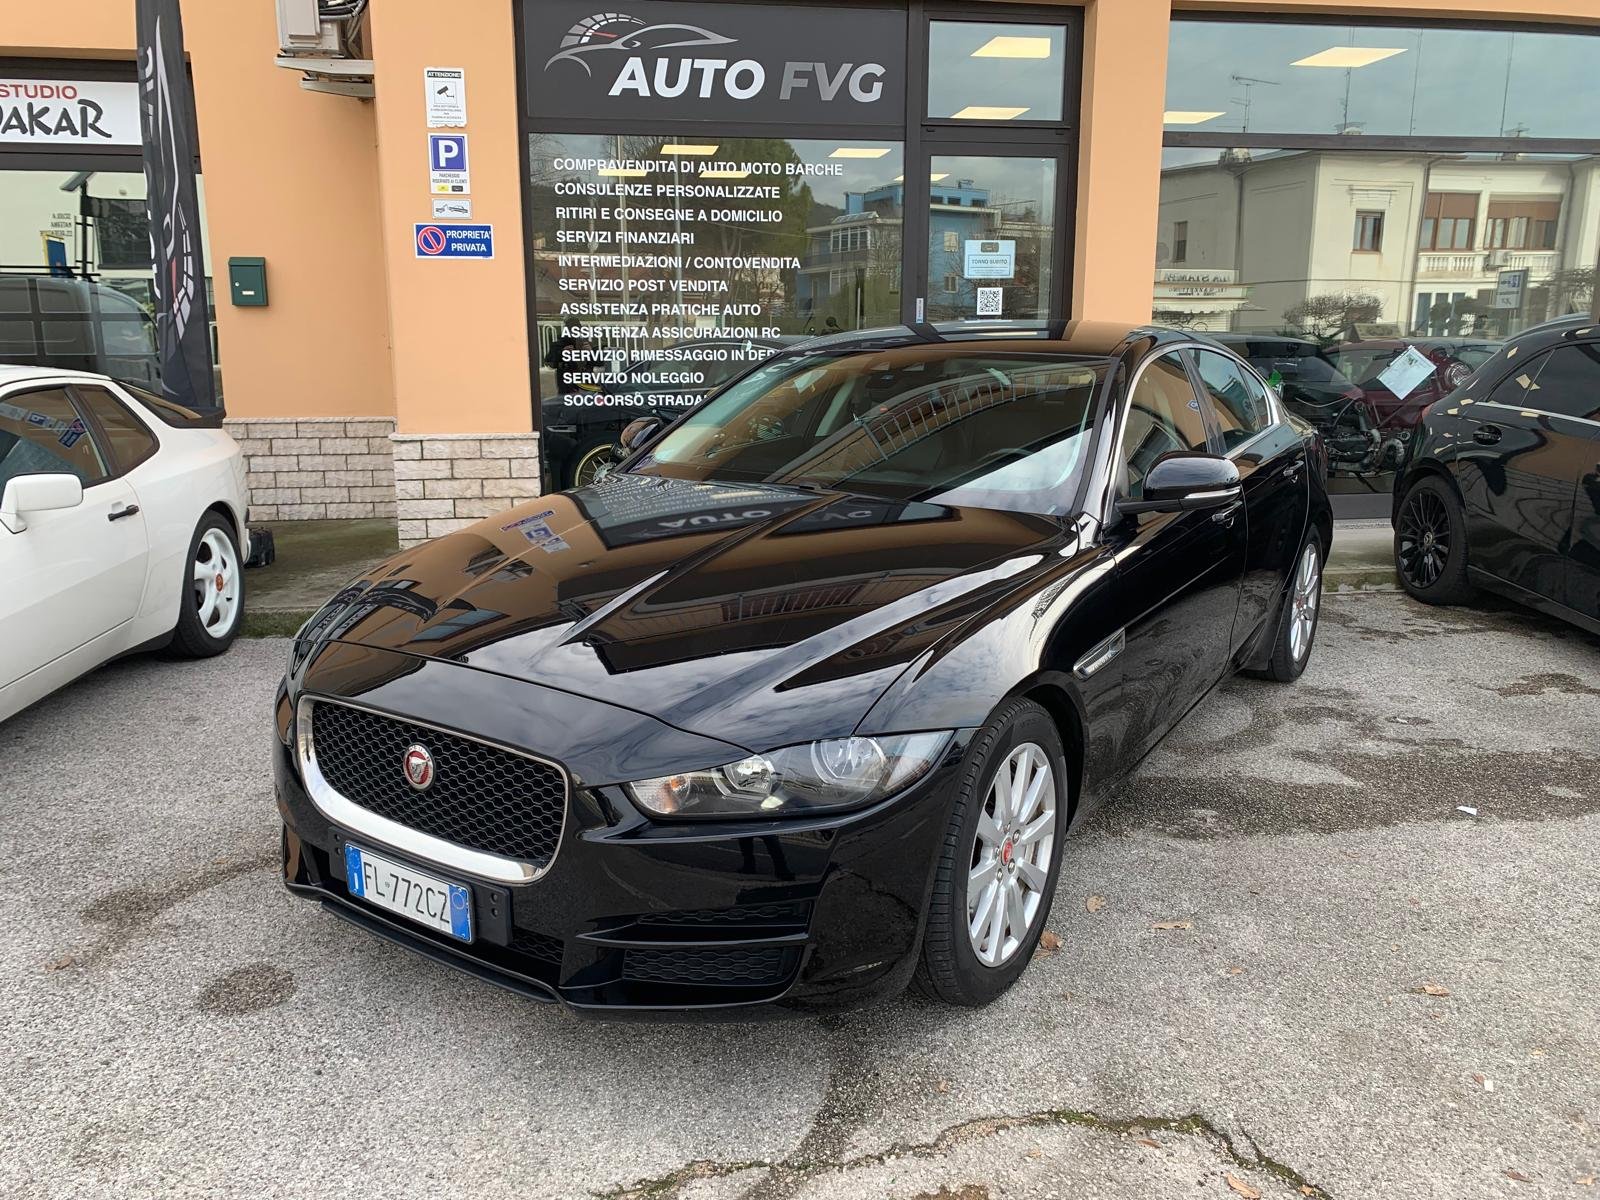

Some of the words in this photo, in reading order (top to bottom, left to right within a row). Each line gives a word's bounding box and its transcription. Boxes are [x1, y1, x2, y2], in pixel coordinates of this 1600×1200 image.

[608, 57, 766, 100] AUTO
[779, 61, 887, 103] FVG
[0, 84, 77, 99] STUDIO
[0, 99, 113, 138] AKAR
[438, 139, 459, 168] P
[553, 158, 677, 173] COMPRAVENDITA
[680, 161, 695, 173] DI
[698, 161, 737, 174] AUTO
[741, 162, 782, 175] MOTO
[785, 163, 844, 176] BARCHE
[554, 183, 652, 196] CONSULENZE
[656, 185, 781, 199] PERSONALIZZATE
[555, 207, 597, 220] RITIRI
[601, 208, 610, 220] E
[614, 208, 694, 221] CONSEGNE
[697, 209, 707, 221] A
[711, 210, 783, 223] DOMICILIO
[556, 230, 611, 243] SERVIZI
[615, 232, 694, 244] FINANZIARI
[451, 243, 487, 252] PRIVATA
[558, 255, 682, 269] INTERMEDIAZIONI
[694, 257, 801, 270] CONTOVENDITA
[559, 279, 624, 291] SERVIZIO
[628, 279, 665, 291] POST
[669, 280, 728, 292] VENDITA
[560, 303, 648, 315] ASSISTENZA
[651, 304, 721, 316] PRATICHE
[723, 304, 761, 316] AUTO
[561, 326, 649, 338] ASSISTENZA
[652, 327, 758, 339] ASSICURAZIONI
[762, 327, 781, 339] RC
[562, 350, 626, 362] SERVIZIO
[630, 349, 728, 361] RIMESSAGGIO
[731, 349, 745, 361] IN
[748, 349, 776, 361] DEP
[563, 372, 628, 384] SERVIZIO
[631, 372, 704, 384] NOLEGGIO
[647, 394, 707, 407] STRADA
